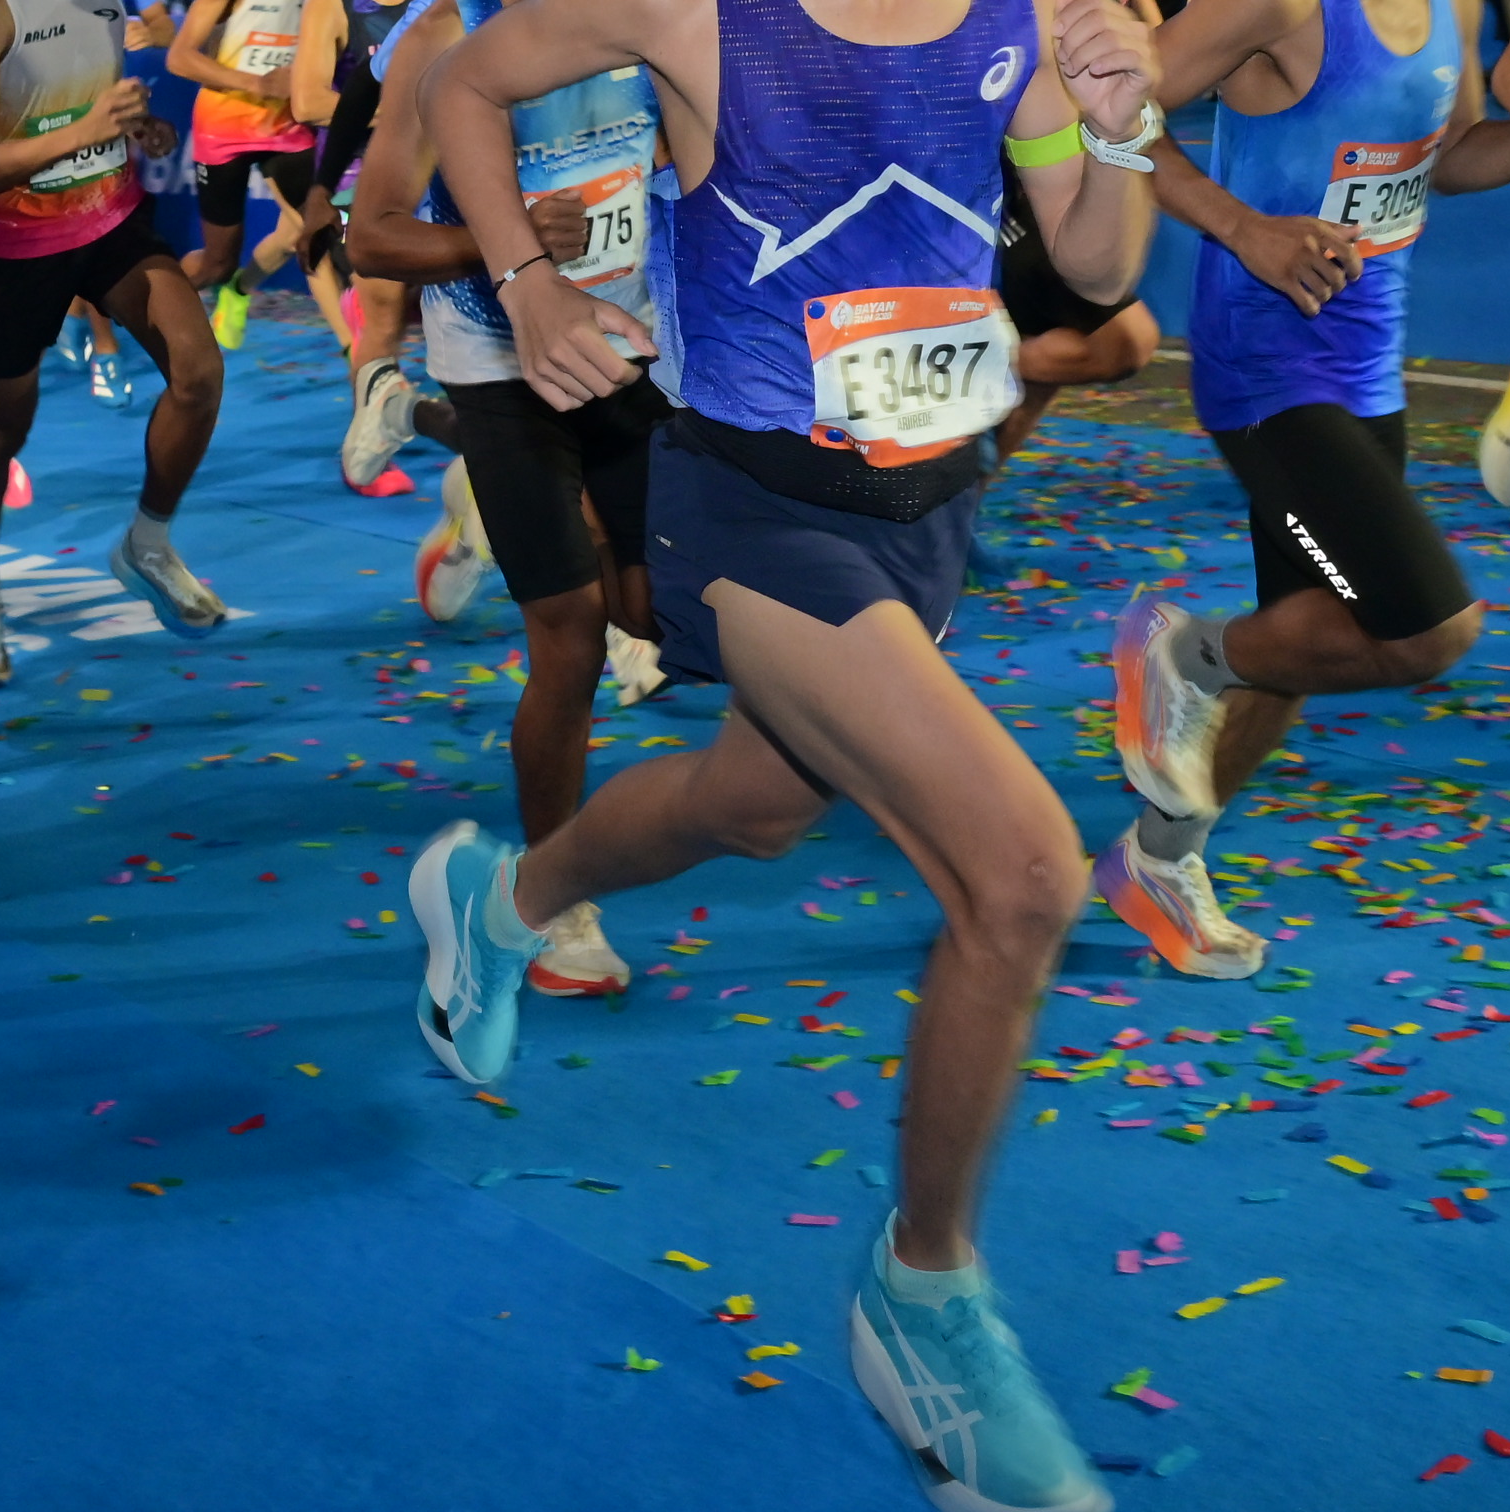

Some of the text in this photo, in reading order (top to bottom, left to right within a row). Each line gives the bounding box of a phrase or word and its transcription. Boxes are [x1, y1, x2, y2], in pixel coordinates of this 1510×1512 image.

[1340, 183, 1367, 224] E
[854, 301, 896, 316] BAYAN
[839, 341, 990, 420] E 3487
[854, 440, 870, 455] KM
[1291, 524, 1358, 600] TERREX
